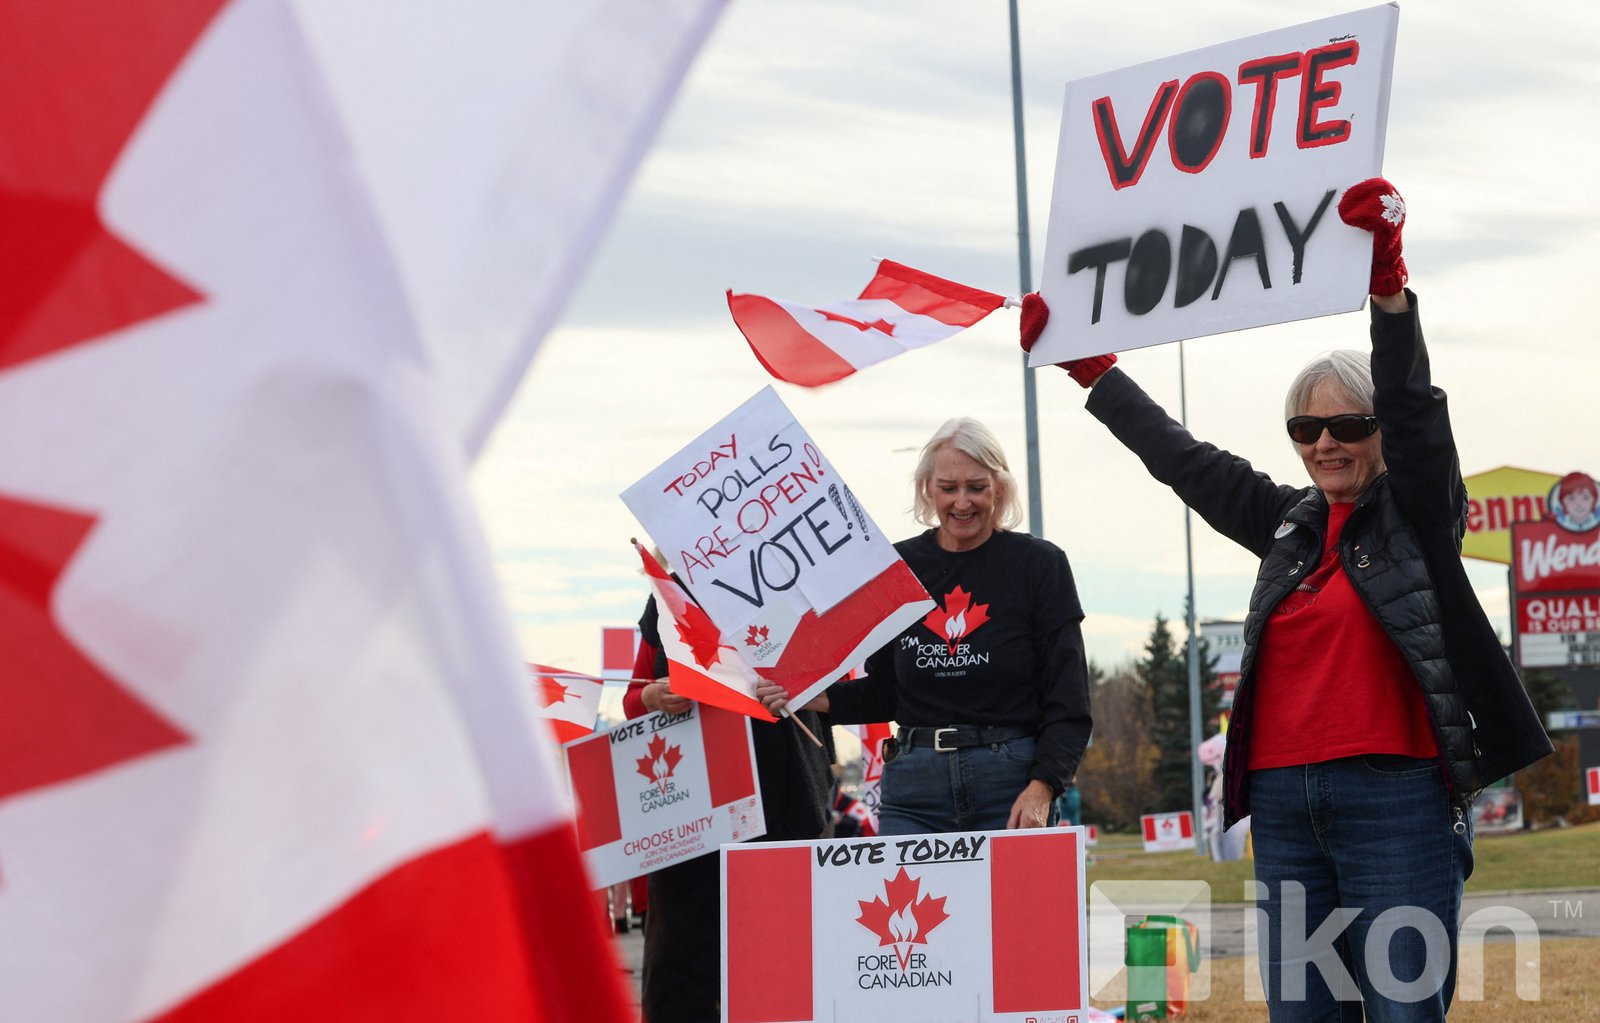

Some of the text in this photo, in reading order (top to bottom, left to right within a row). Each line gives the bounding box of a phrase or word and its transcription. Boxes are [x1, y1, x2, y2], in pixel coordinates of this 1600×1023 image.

[1092, 40, 1359, 190] VOTE
[1067, 189, 1337, 324] TODAY
[663, 434, 737, 496] TODAY
[697, 434, 792, 519] POLLS
[681, 443, 825, 584] ARE OPEN!
[915, 652, 989, 668] CANADIAN
[917, 638, 971, 657] FOREVER
[610, 720, 645, 744] VOTE
[640, 779, 675, 802] FOREVER
[641, 789, 690, 813] CANADIAN
[624, 815, 714, 856] CHOOSE UNITY
[816, 835, 987, 867] VOTE TODAY
[858, 944, 926, 972] FOREVER
[858, 970, 952, 990] CANADIAN
